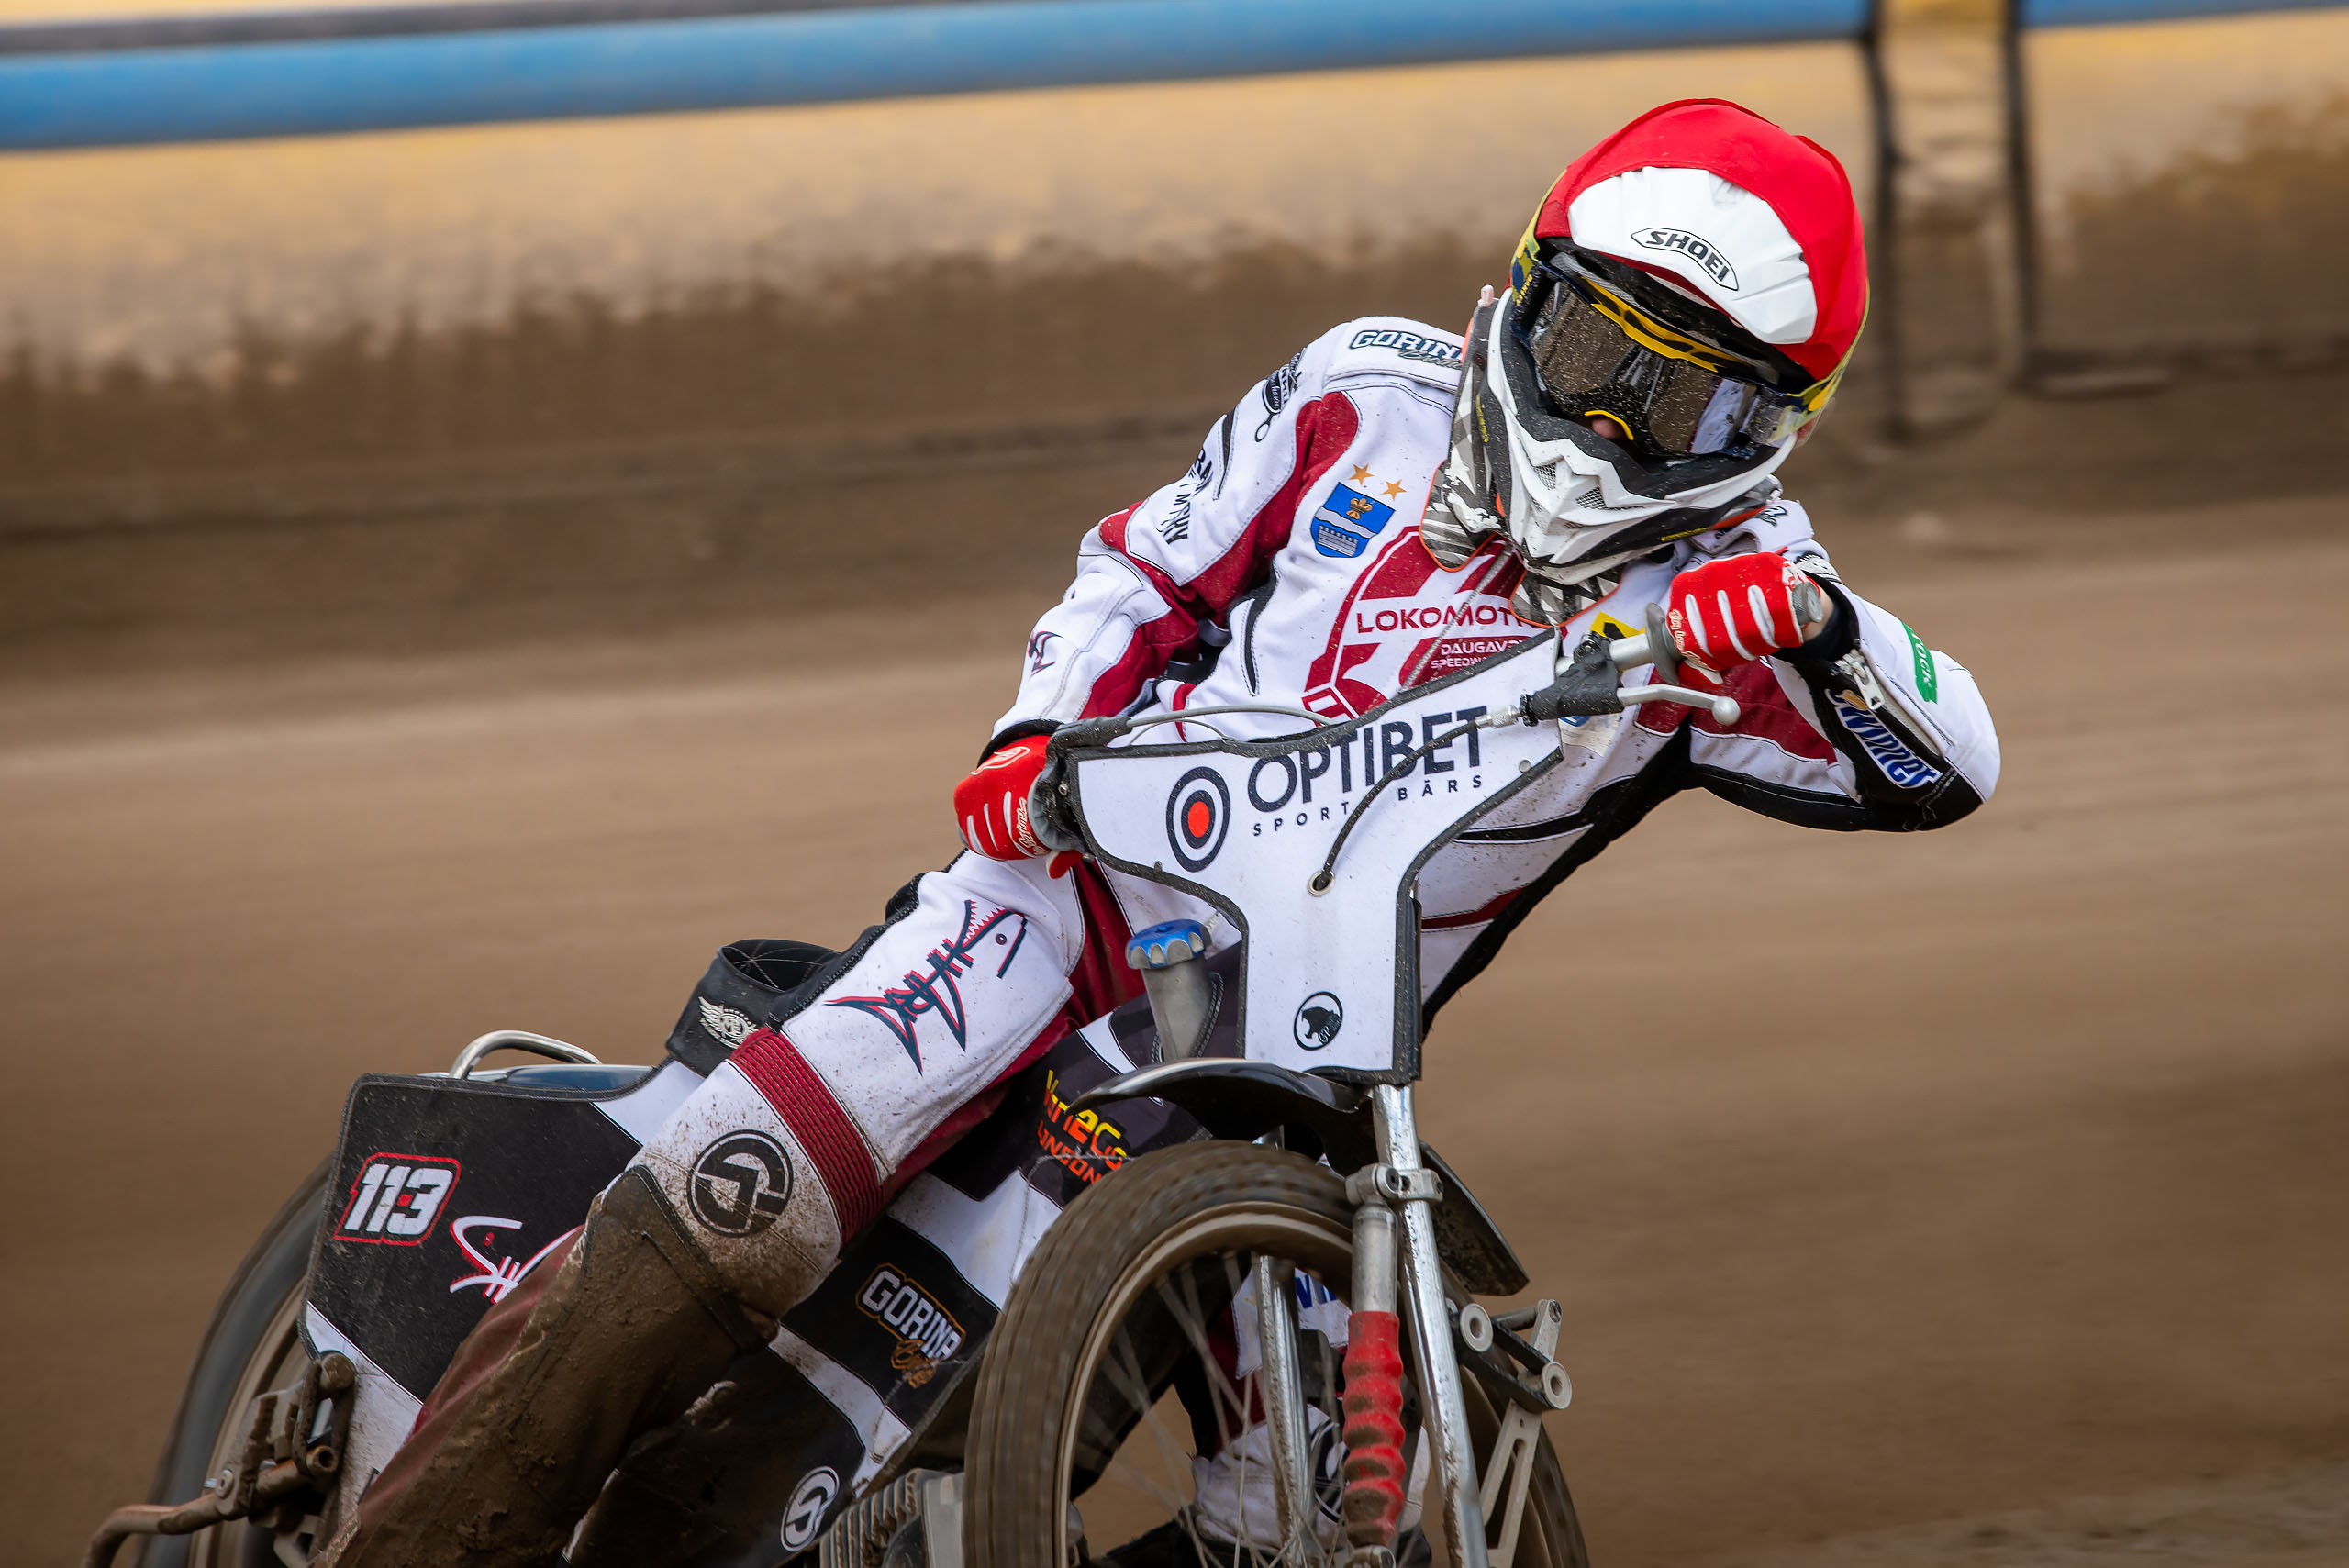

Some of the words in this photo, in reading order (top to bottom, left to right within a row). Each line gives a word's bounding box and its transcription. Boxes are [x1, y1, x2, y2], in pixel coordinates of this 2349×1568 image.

[1645, 230, 1730, 282] SHOEI
[1350, 329, 1464, 362] GORIN
[1356, 602, 1537, 634] LOKOMOT
[1431, 656, 1487, 670] SPEEDW
[1441, 639, 1523, 656] DAUGAV
[1247, 706, 1487, 813] OPTIBET
[1252, 796, 1371, 837] SPORT
[1397, 775, 1483, 802] BĀRS
[344, 1162, 454, 1236] 113
[861, 1269, 963, 1360] GORINA
